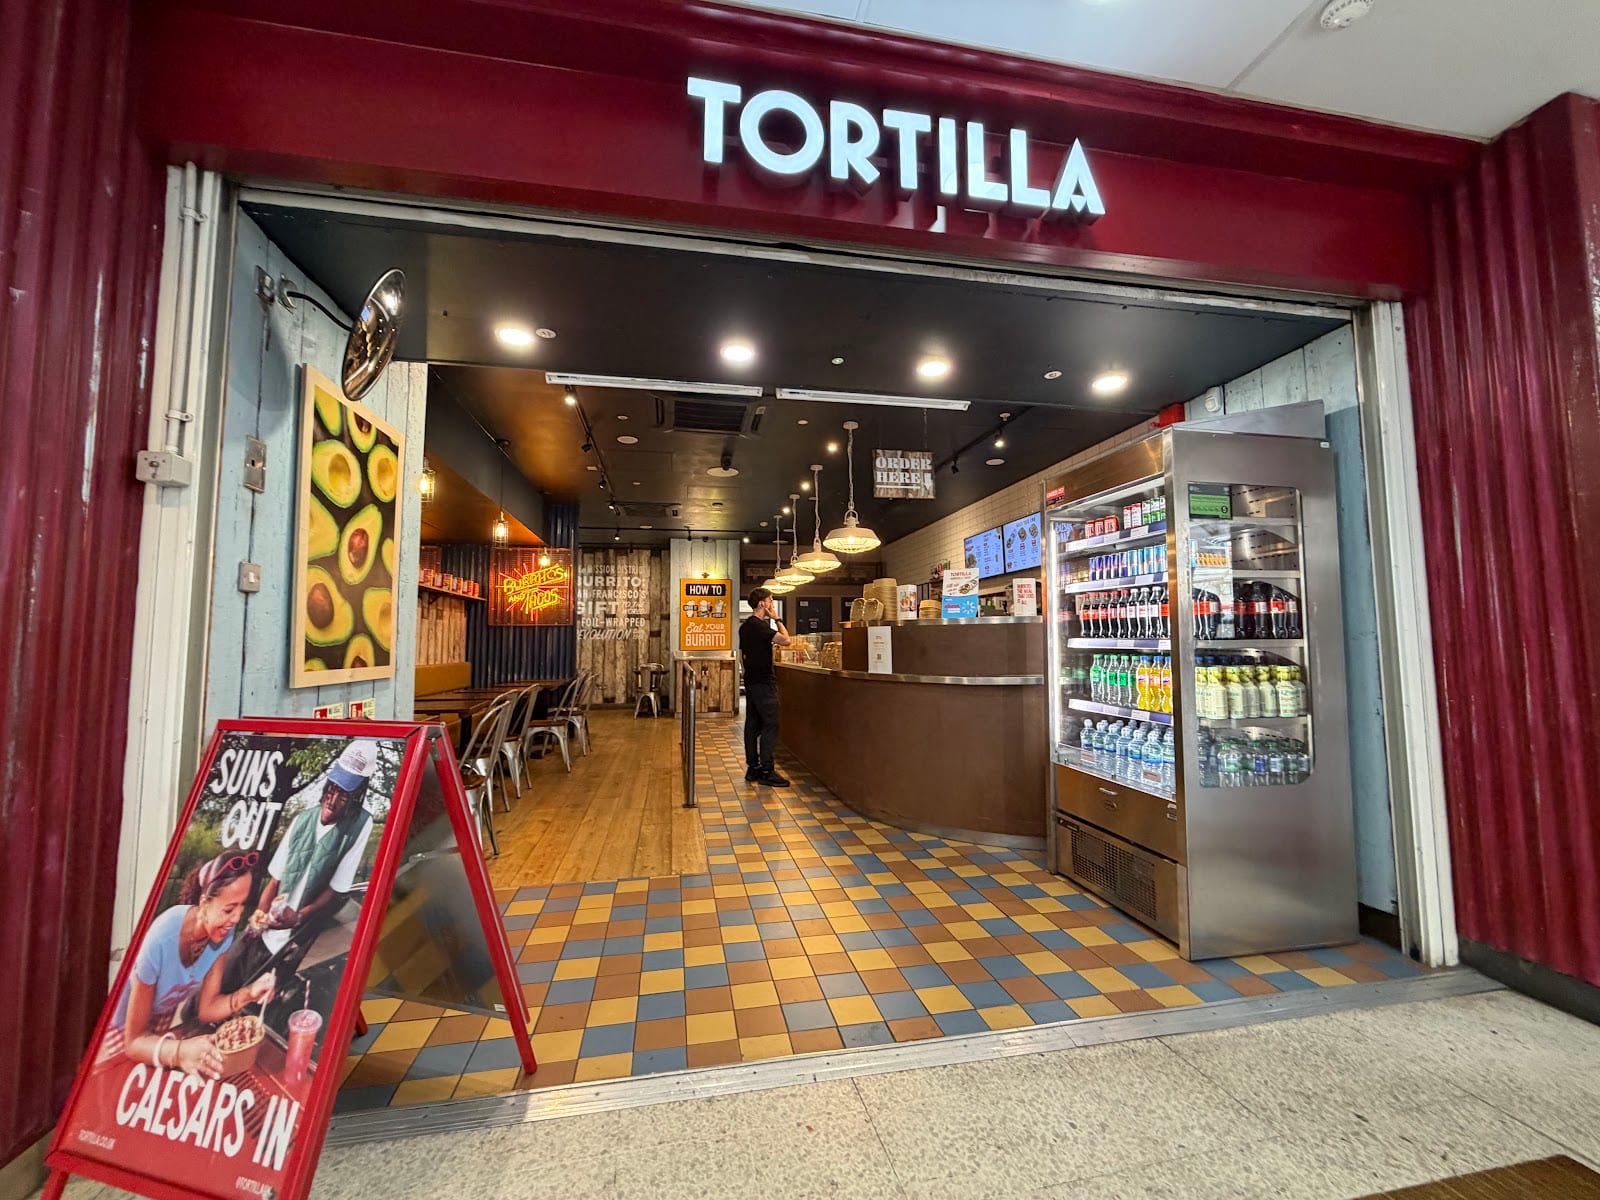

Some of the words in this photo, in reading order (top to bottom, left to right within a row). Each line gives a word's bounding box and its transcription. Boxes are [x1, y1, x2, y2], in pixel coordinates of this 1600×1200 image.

[687, 77, 1106, 215] TORTILLA
[875, 456, 932, 470] ORDER
[876, 471, 921, 484] HERE
[503, 567, 565, 594] BURRITOS
[593, 589, 646, 599] FRANCISCO'S
[689, 585, 710, 595] HOW
[711, 585, 722, 595] TO
[508, 593, 526, 603] AND
[524, 587, 559, 614] TACOS
[581, 617, 646, 628] FOIL-WRAPPED
[685, 621, 704, 633] Eat
[685, 633, 726, 647] BURRITO
[209, 748, 284, 798] SUNS
[221, 799, 283, 851] OUT
[116, 1063, 255, 1158] CAESARS
[252, 1094, 300, 1172] IN
